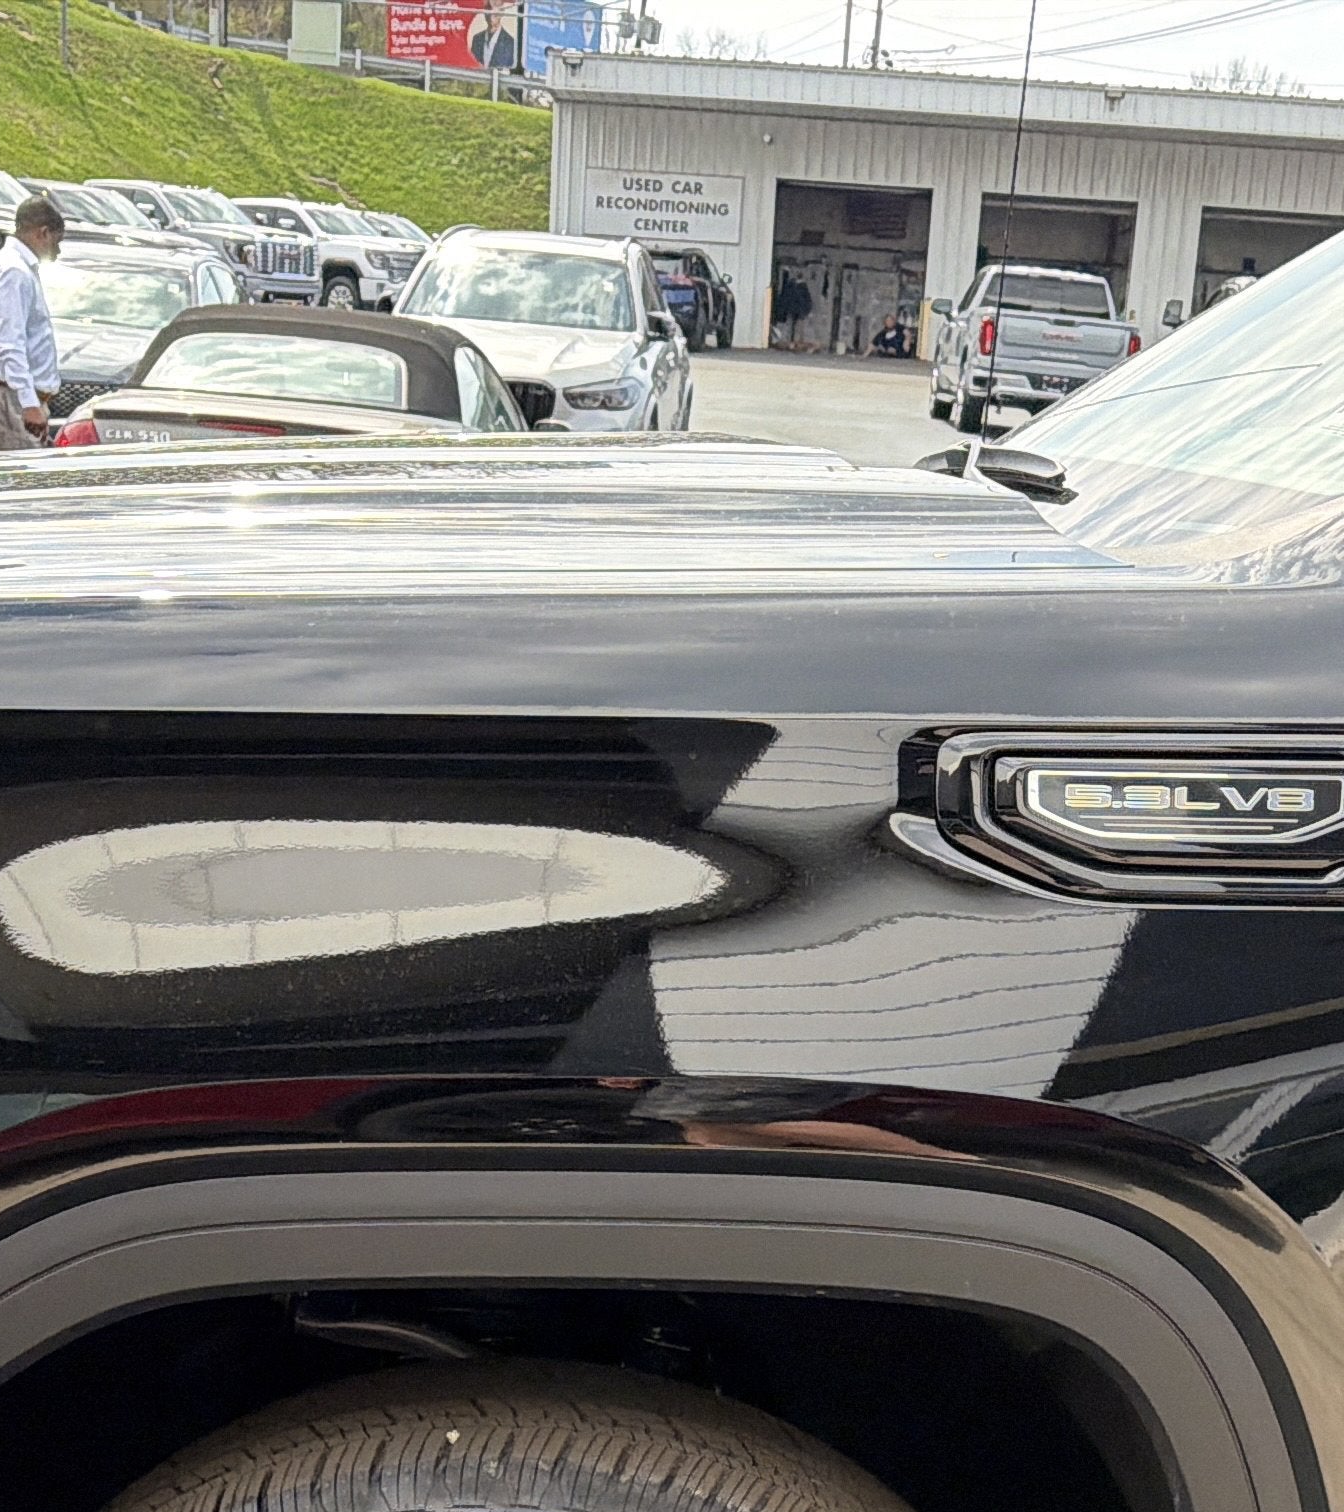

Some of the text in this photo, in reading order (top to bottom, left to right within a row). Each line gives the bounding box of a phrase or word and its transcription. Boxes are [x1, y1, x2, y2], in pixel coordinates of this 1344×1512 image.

[622, 177, 704, 195] USED CAR
[596, 195, 729, 216] RECONDITIONING
[634, 218, 689, 233] CENTER
